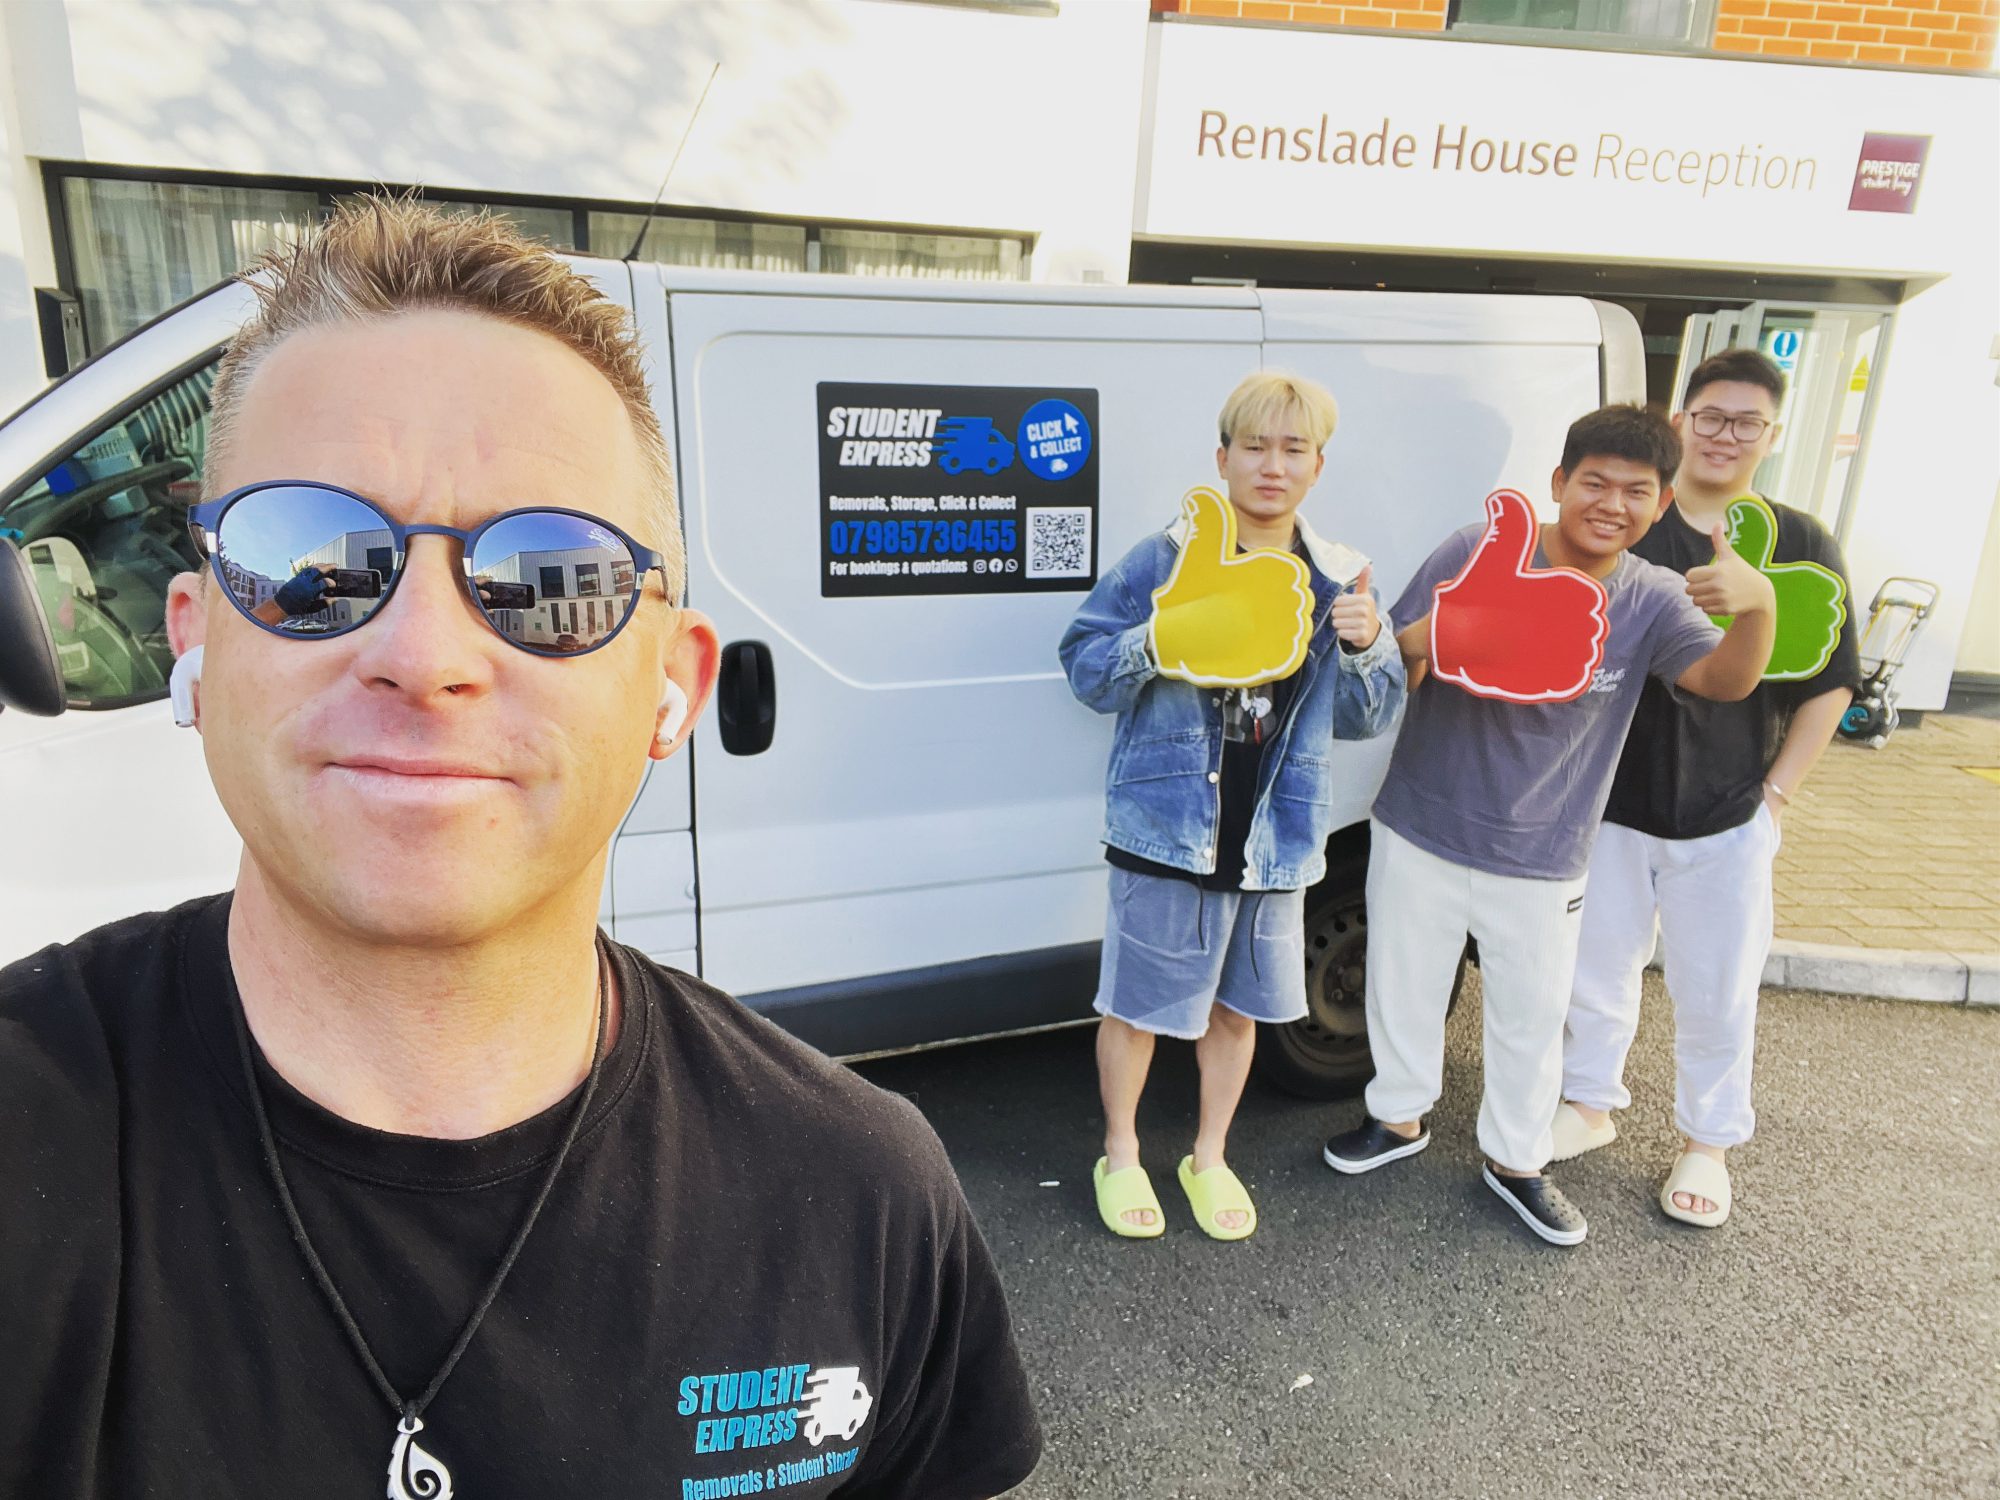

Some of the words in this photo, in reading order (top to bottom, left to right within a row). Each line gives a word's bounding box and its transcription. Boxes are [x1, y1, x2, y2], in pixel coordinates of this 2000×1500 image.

[1197, 109, 1417, 169] Renslade
[1432, 123, 1579, 178] House
[1592, 133, 1817, 199] Reception
[1861, 159, 1921, 178] PRESTIGE
[826, 406, 943, 438] STUDENT
[1026, 419, 1064, 442] CLICK
[839, 440, 933, 467] EXPRESS
[1039, 436, 1082, 457] COLLECT
[829, 495, 889, 511] Removals,
[890, 496, 938, 512] Storage,
[939, 495, 967, 511] Click
[969, 497, 977, 510] &
[978, 495, 1017, 510] Collect
[829, 520, 1017, 554] 07985736455
[829, 561, 848, 575] For
[849, 560, 900, 576] bookings
[901, 561, 909, 574] &
[911, 559, 968, 576] quotations
[677, 1363, 811, 1416] STUDENT
[695, 1407, 799, 1454] EXPRESS
[682, 1470, 763, 1500] Removals
[766, 1468, 776, 1490] &
[778, 1455, 825, 1487] Student
